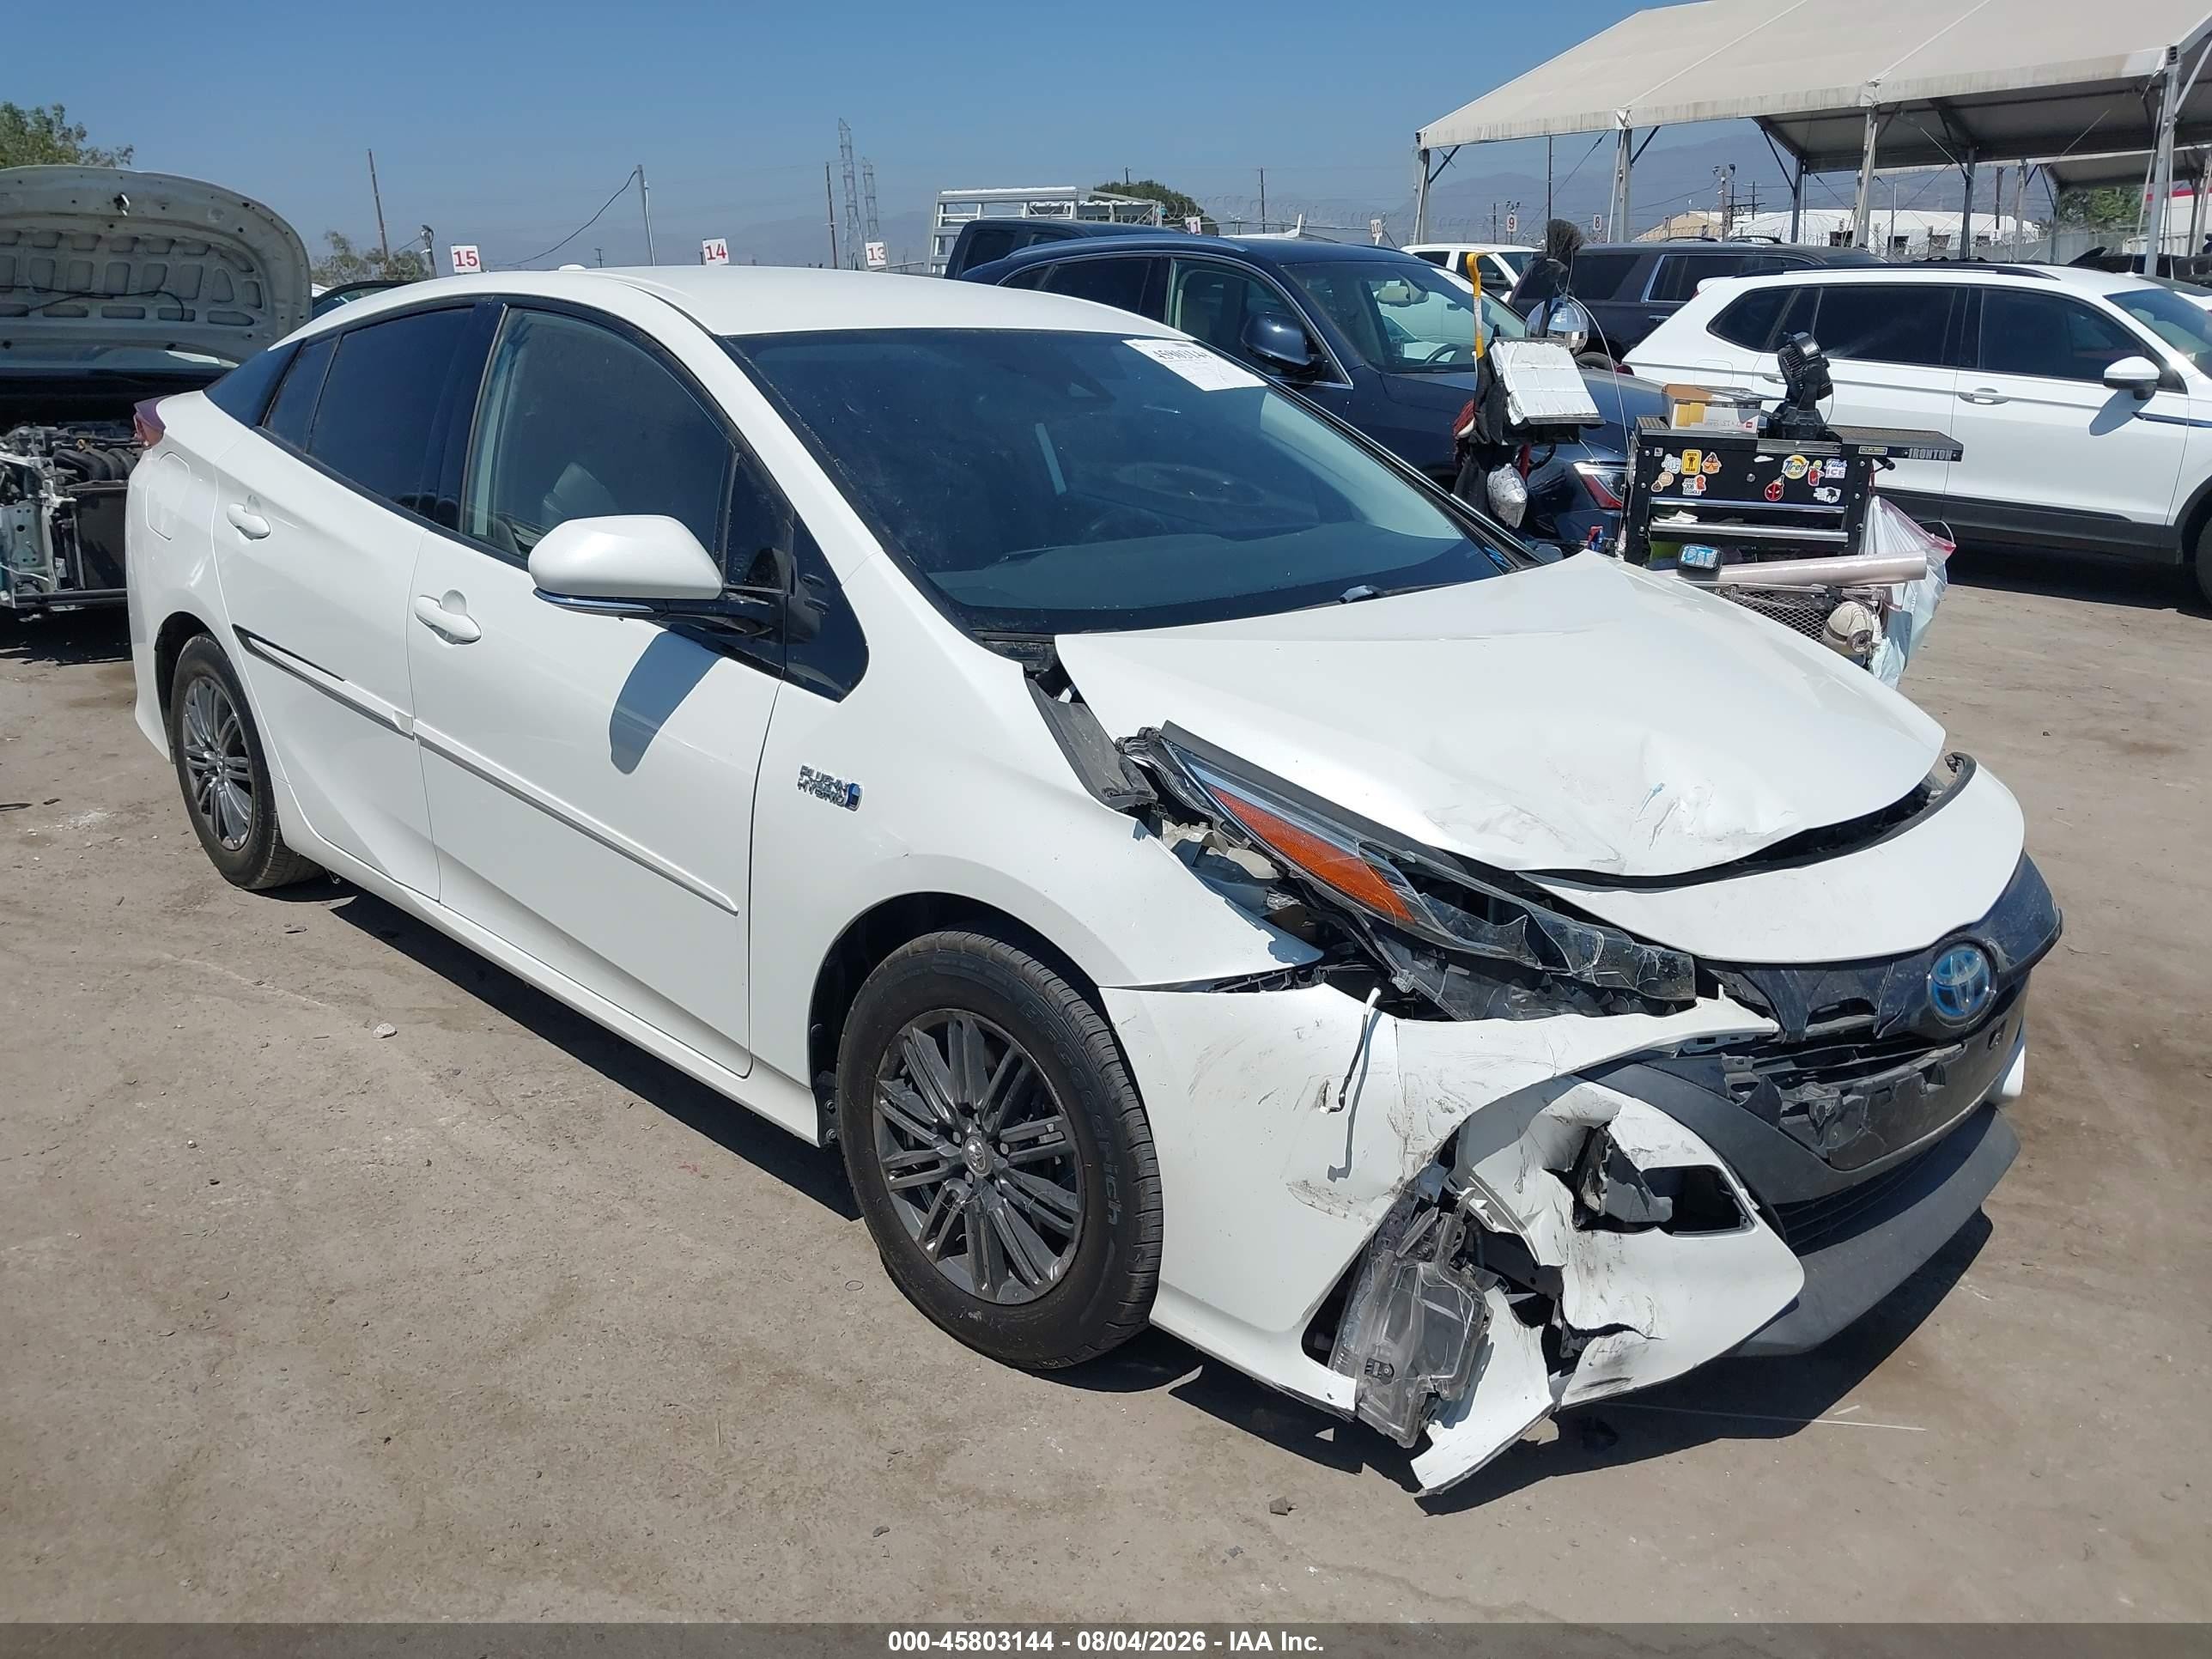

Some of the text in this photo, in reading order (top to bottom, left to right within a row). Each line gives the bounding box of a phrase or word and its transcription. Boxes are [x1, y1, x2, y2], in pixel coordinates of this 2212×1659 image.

[1187, 220, 1200, 234] 11
[1371, 222, 1382, 234] 10
[1509, 216, 1515, 230] 9
[1595, 216, 1601, 228] 8
[1838, 221, 1844, 232] 5
[1992, 231, 2000, 240] 1
[453, 250, 478, 267] 15
[705, 243, 727, 261] 14
[868, 246, 885, 261] 13
[1908, 447, 1954, 460] IRONTON
